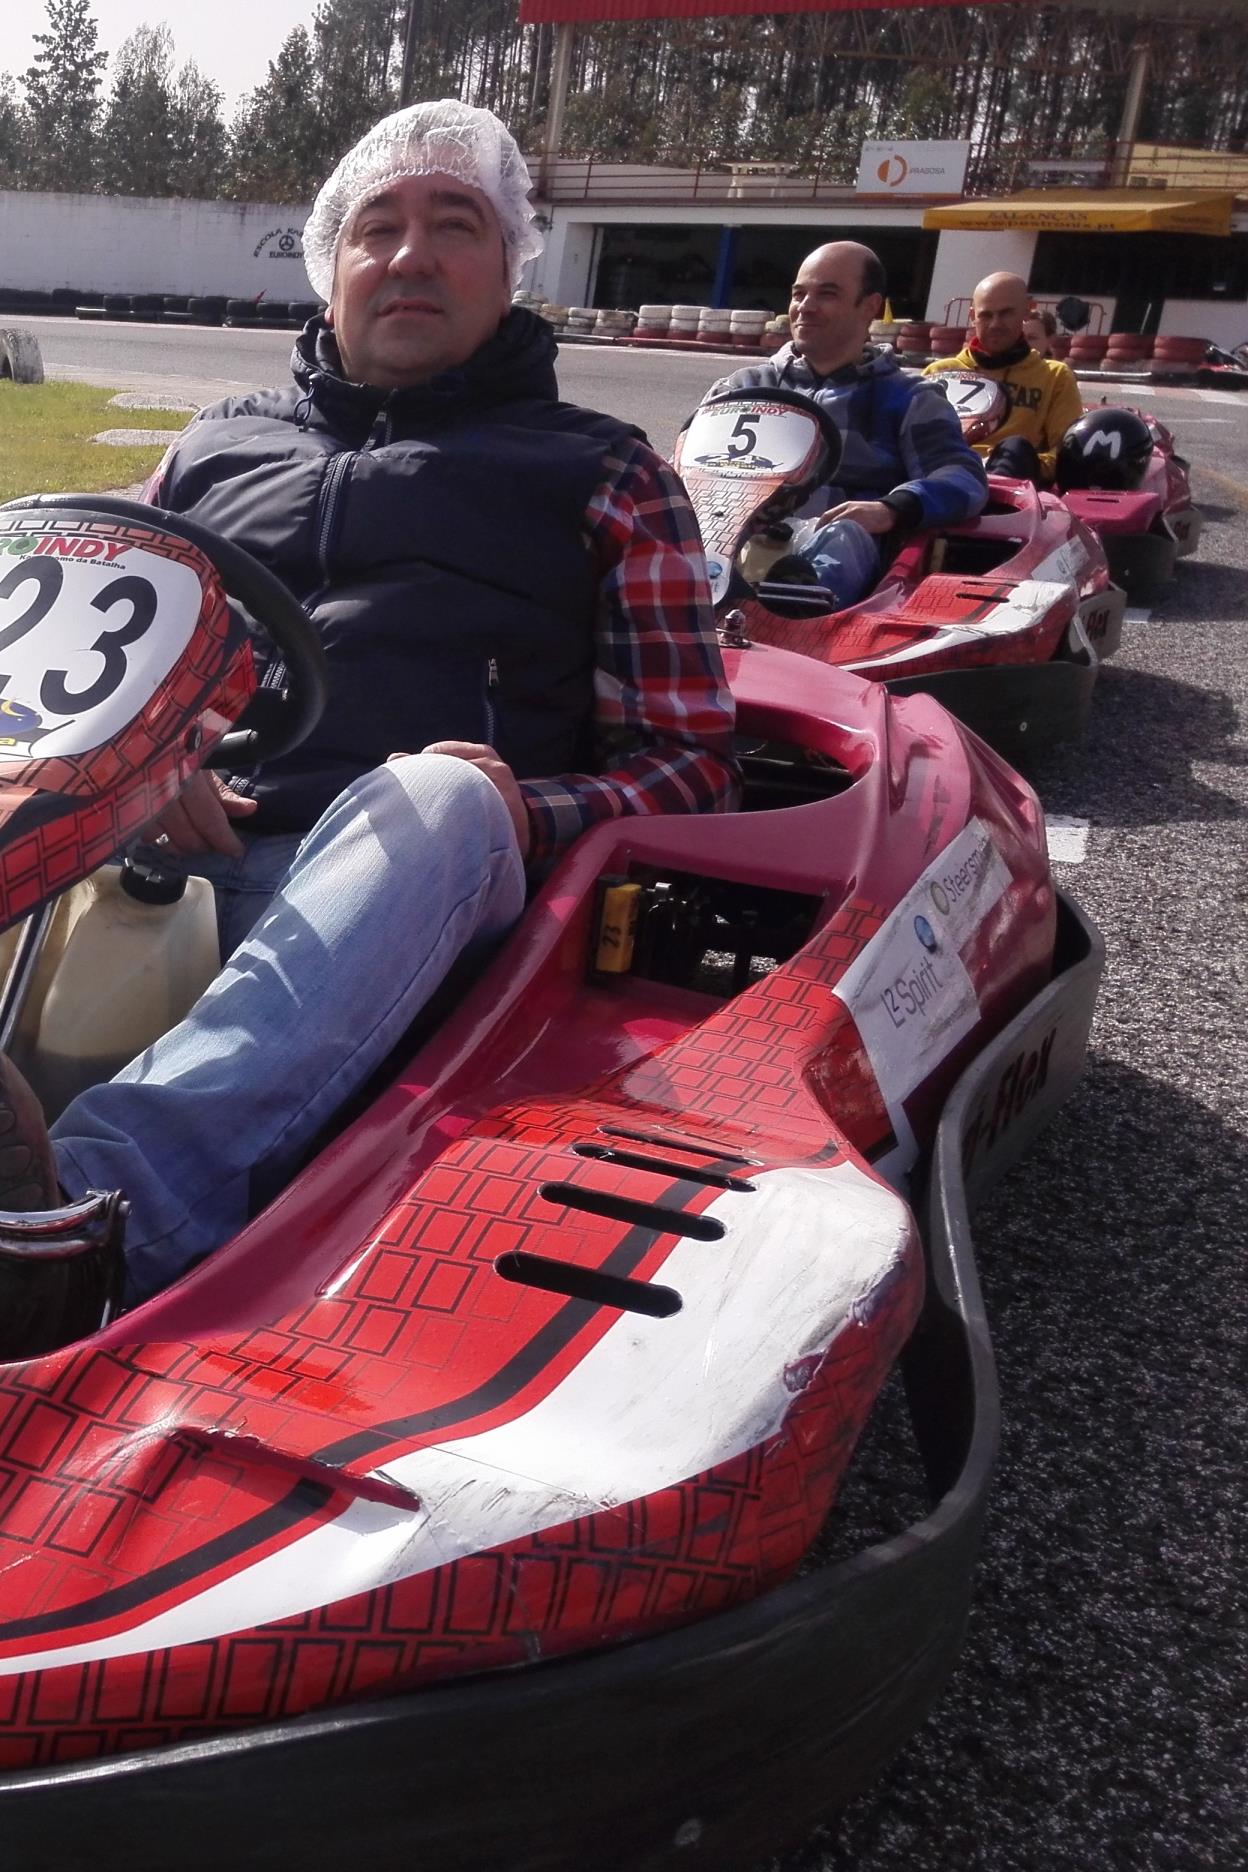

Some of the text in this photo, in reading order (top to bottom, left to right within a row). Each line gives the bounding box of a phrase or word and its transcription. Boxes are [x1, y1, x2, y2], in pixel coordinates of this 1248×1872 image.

[253, 228, 283, 258] ESCOLA
[727, 414, 761, 459] 5
[1082, 430, 1123, 459] M
[76, 556, 88, 564] da
[89, 558, 127, 570] Batalha
